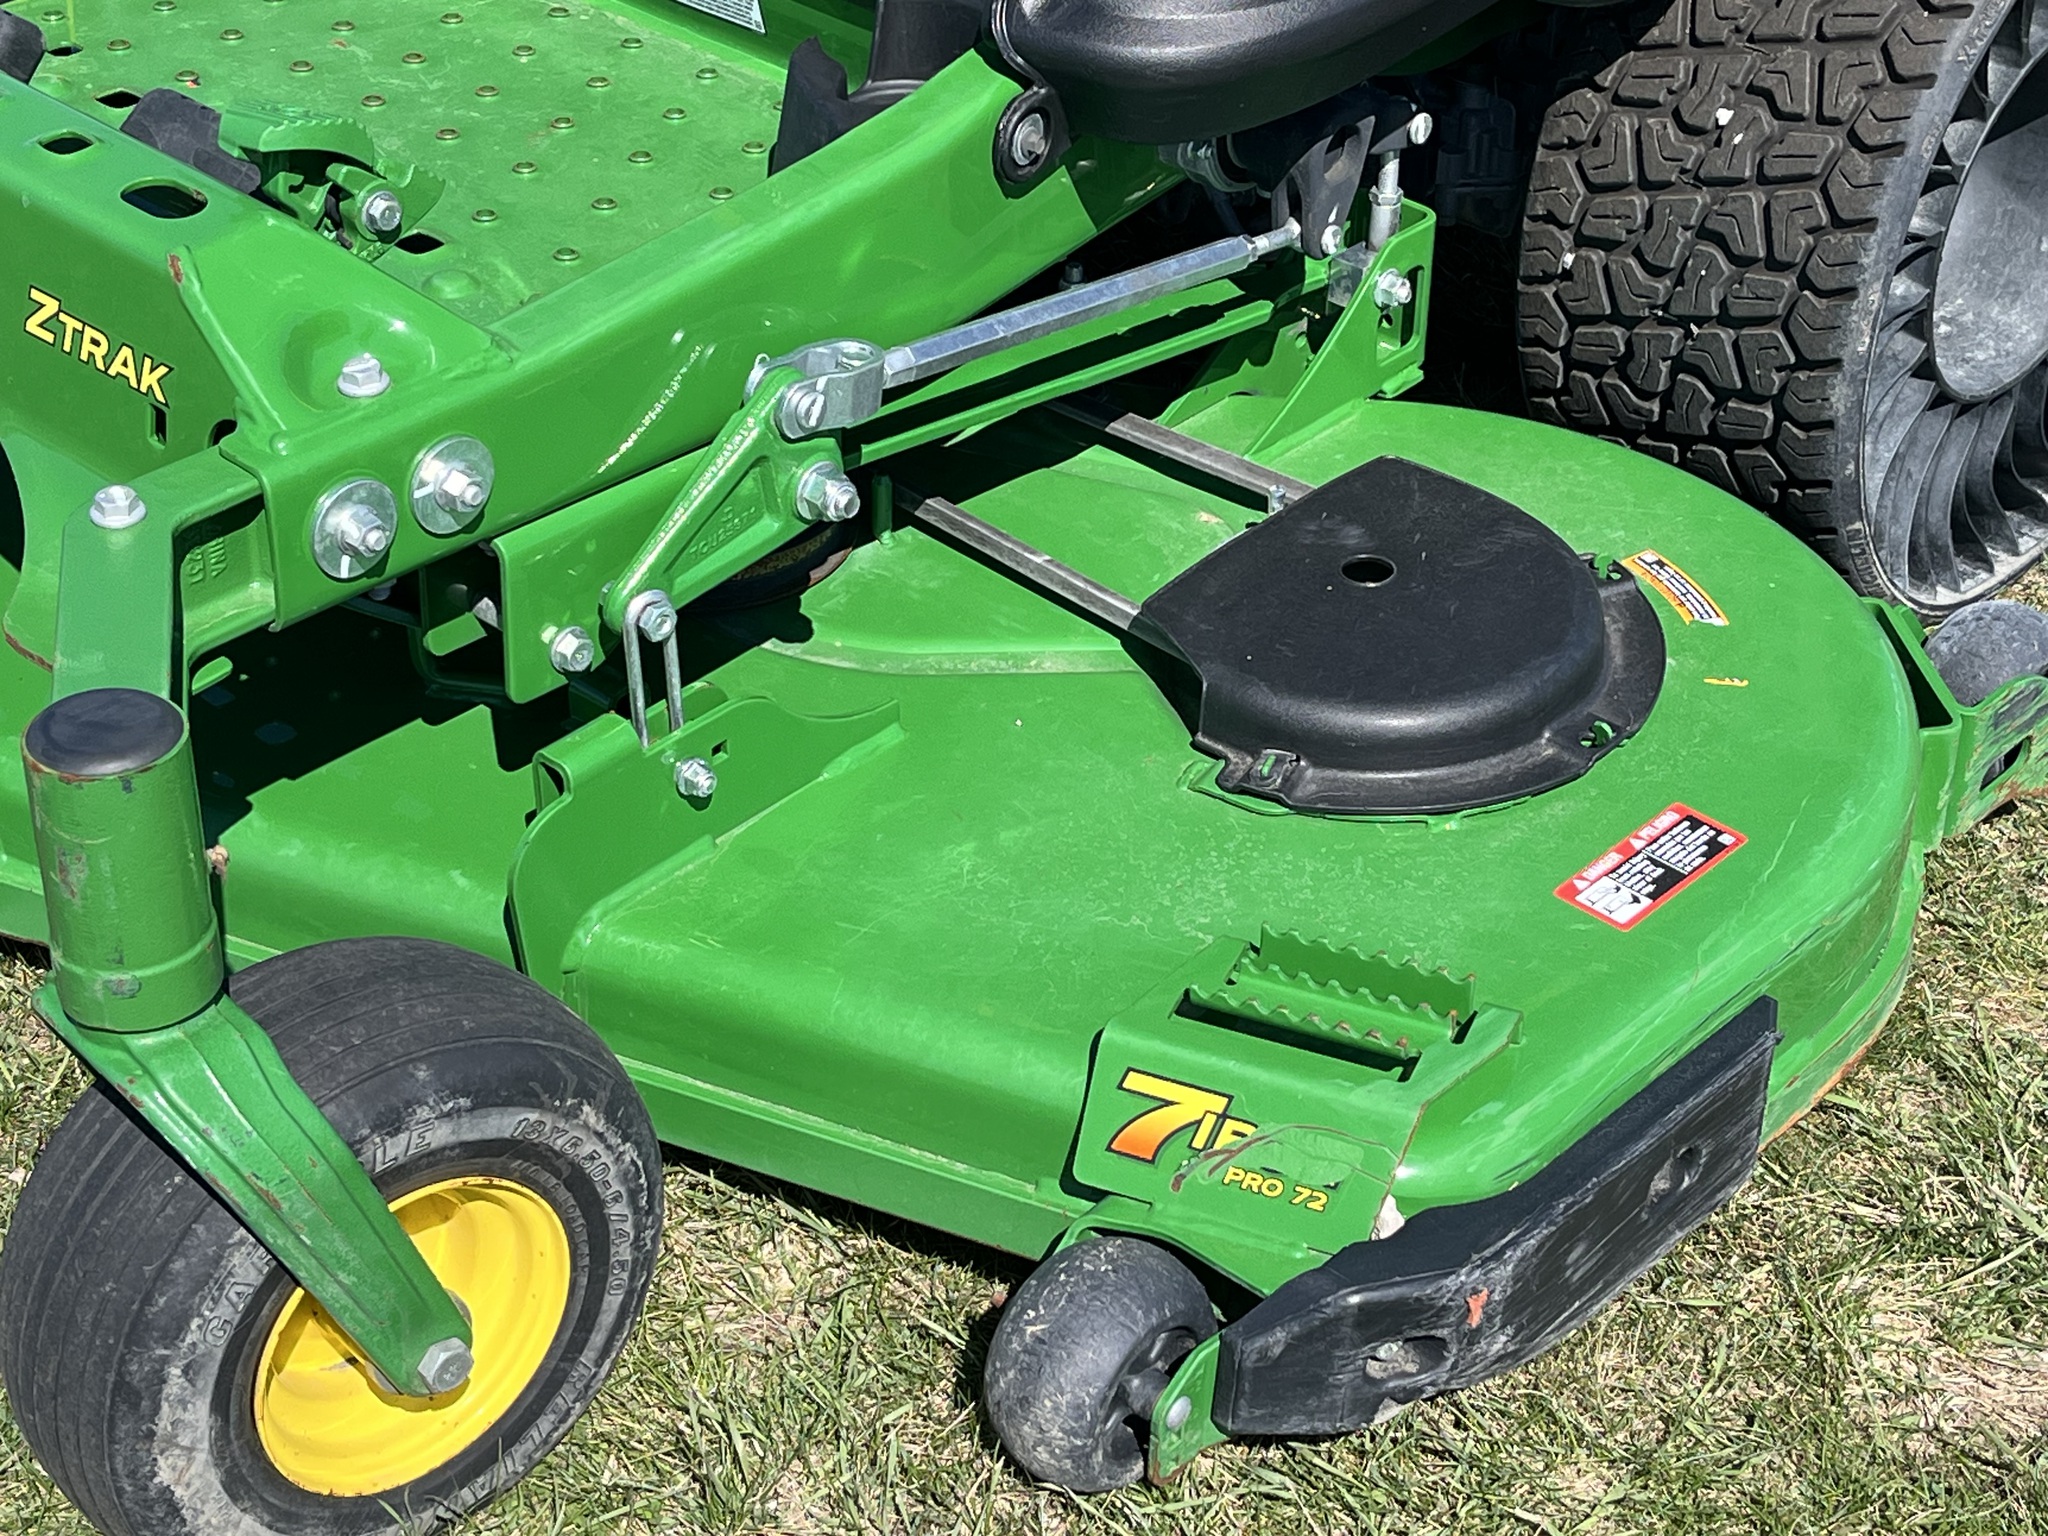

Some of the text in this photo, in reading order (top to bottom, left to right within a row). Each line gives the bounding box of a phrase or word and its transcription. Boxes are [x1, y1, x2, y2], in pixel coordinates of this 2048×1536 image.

[23, 285, 174, 409] ZTRAK
[1582, 851, 1624, 881] DANGER
[1222, 1166, 1330, 1213] PRO 72
